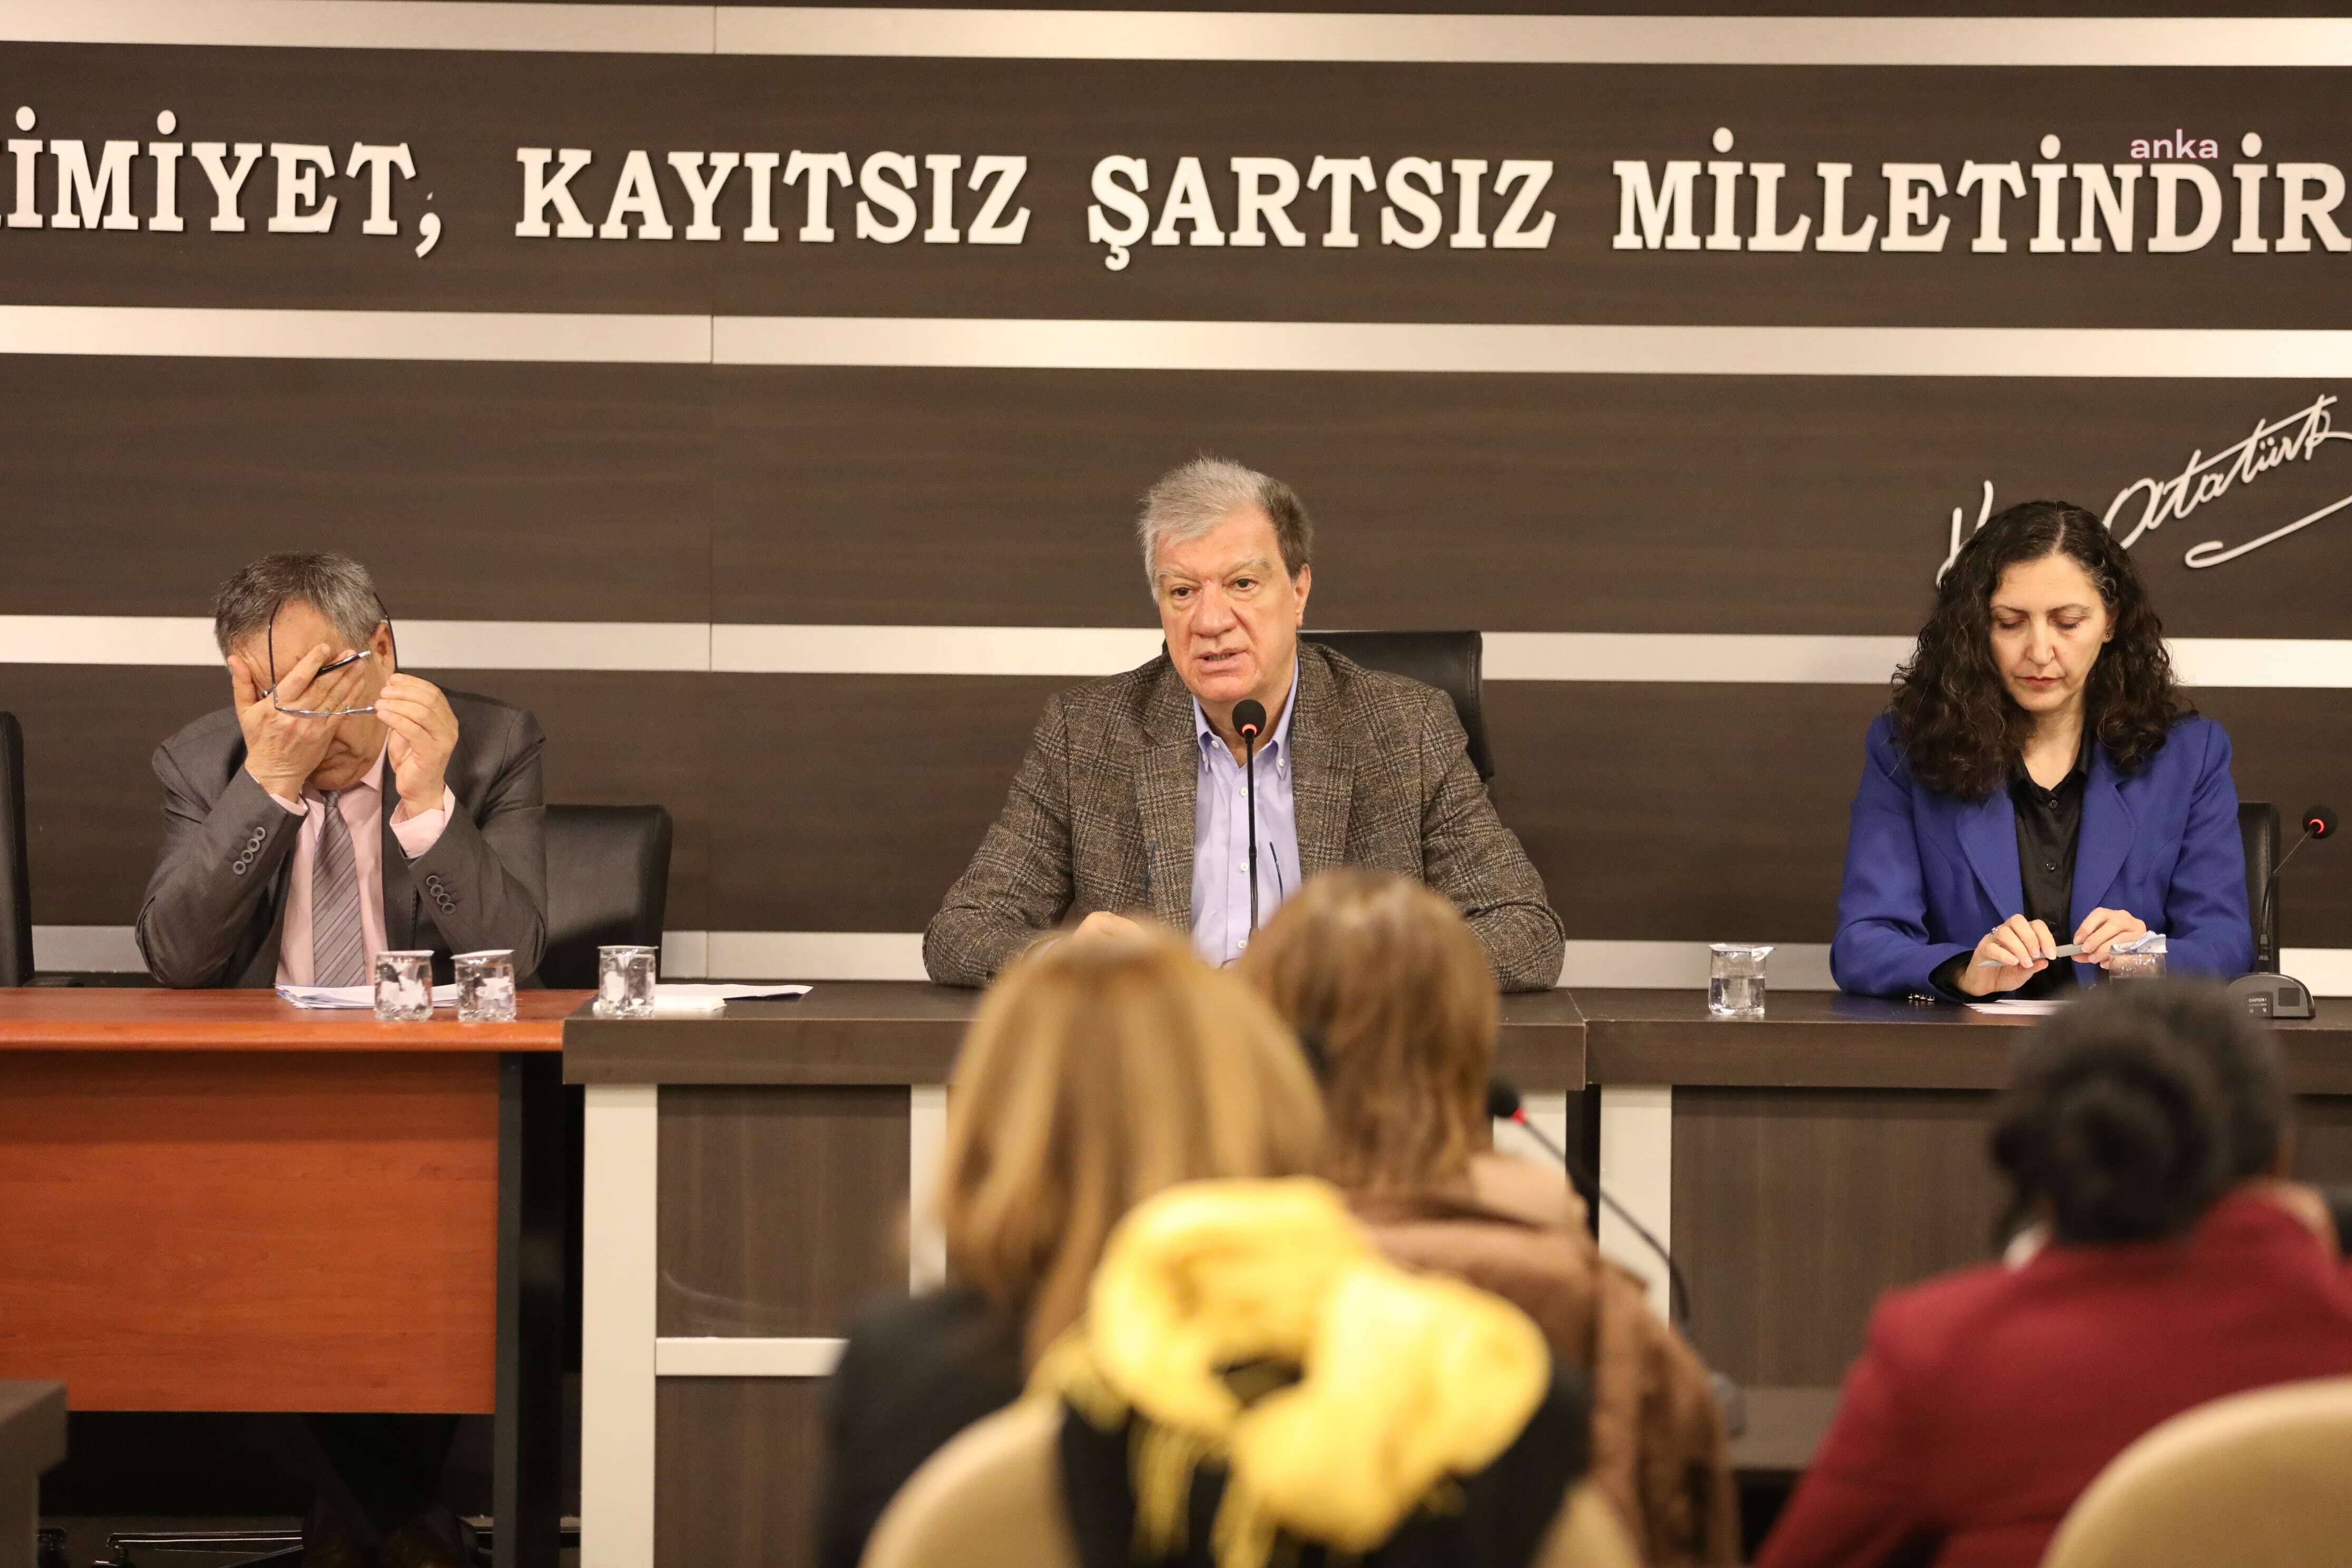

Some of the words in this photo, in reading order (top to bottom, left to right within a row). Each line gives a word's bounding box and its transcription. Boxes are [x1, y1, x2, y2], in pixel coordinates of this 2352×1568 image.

[0, 106, 441, 258] İMİYET,
[515, 148, 1031, 244] KAYITSIZ
[1087, 155, 1556, 271] ŞARTSIZ
[1612, 127, 2352, 253] MİLLETİNDİR
